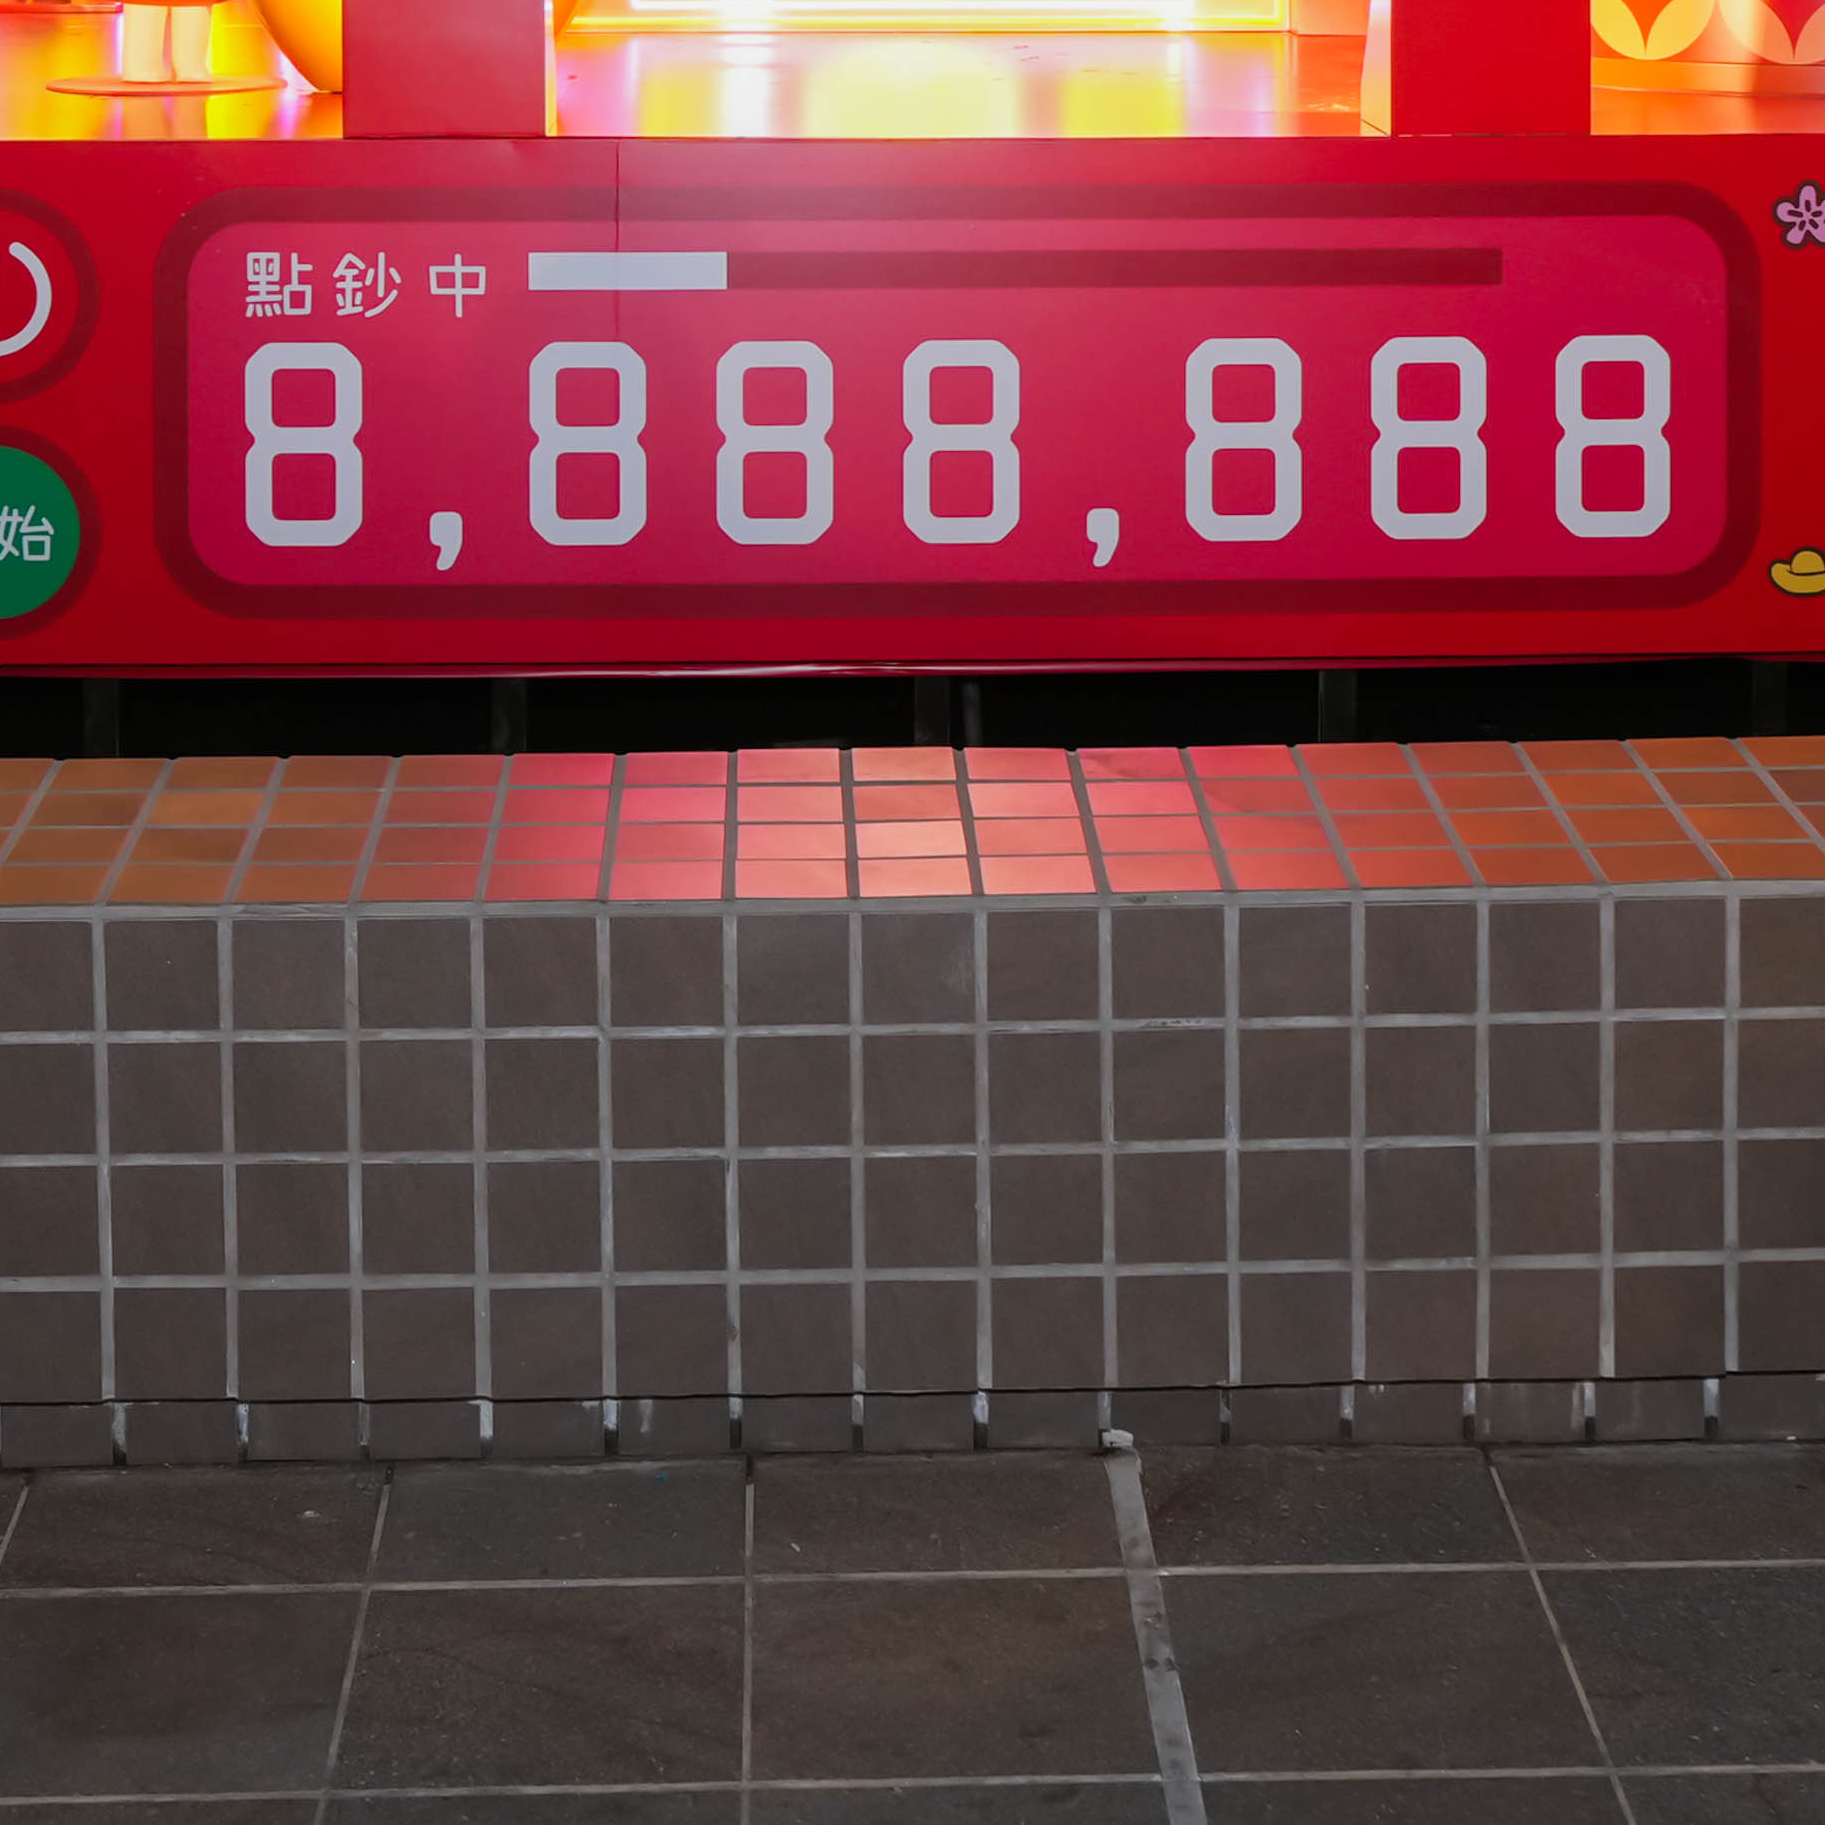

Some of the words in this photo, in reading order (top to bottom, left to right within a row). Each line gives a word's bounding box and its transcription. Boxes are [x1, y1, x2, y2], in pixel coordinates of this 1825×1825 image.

[245, 251, 487, 319] 點鈔中
[244, 334, 1672, 571] 8,888,888
